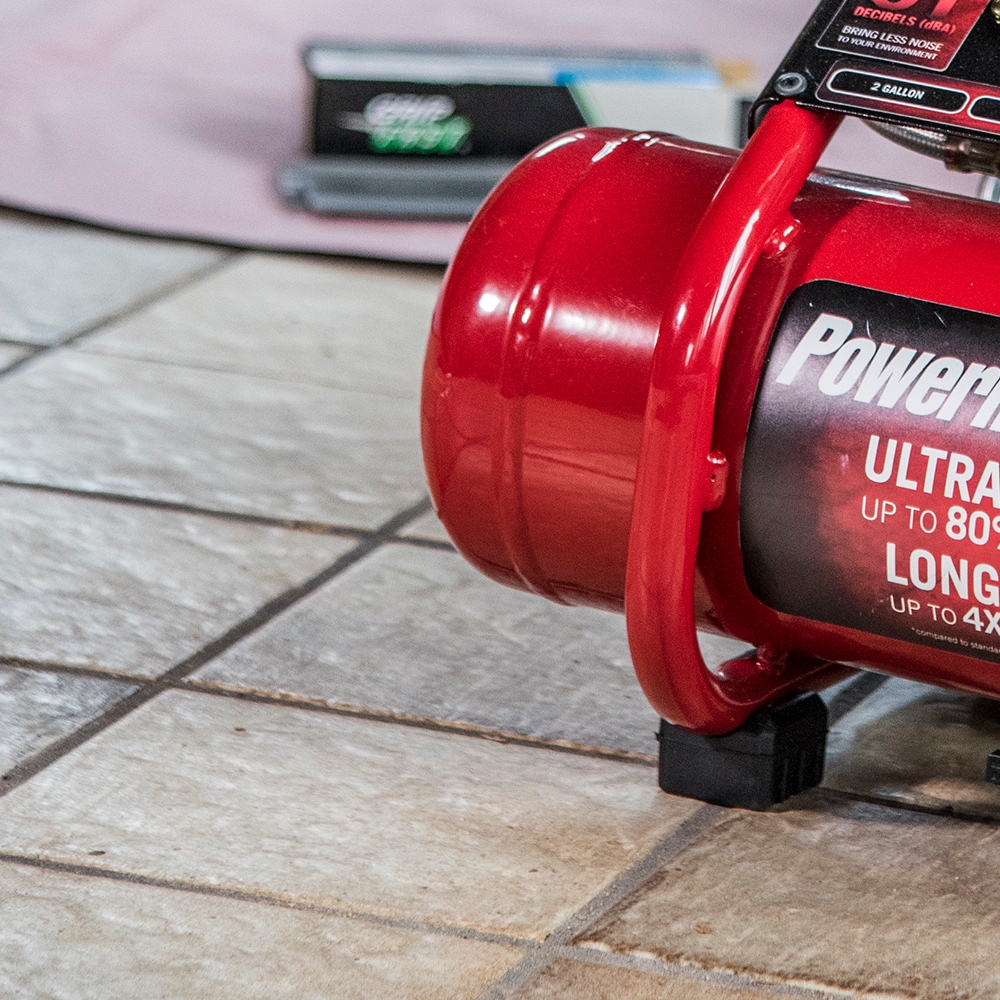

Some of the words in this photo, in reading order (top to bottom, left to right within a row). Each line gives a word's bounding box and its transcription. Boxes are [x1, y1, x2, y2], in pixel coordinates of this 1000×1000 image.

[853, 6, 917, 26] DECIBELS
[919, 18, 957, 35] (dBA)
[837, 35, 849, 43] TO
[850, 38, 875, 48] YOUR
[875, 42, 938, 60] ENVIRONMENT
[842, 25, 879, 39] BRING
[880, 32, 908, 44] LESS
[908, 38, 944, 52] NOISE
[870, 82, 881, 91] 2
[882, 84, 926, 100] GALLON
[861, 495, 897, 523] UP
[905, 505, 937, 534] TO
[886, 542, 1000, 608] LONG
[889, 594, 921, 616] UP
[927, 603, 957, 625] TO
[960, 639, 969, 647] to
